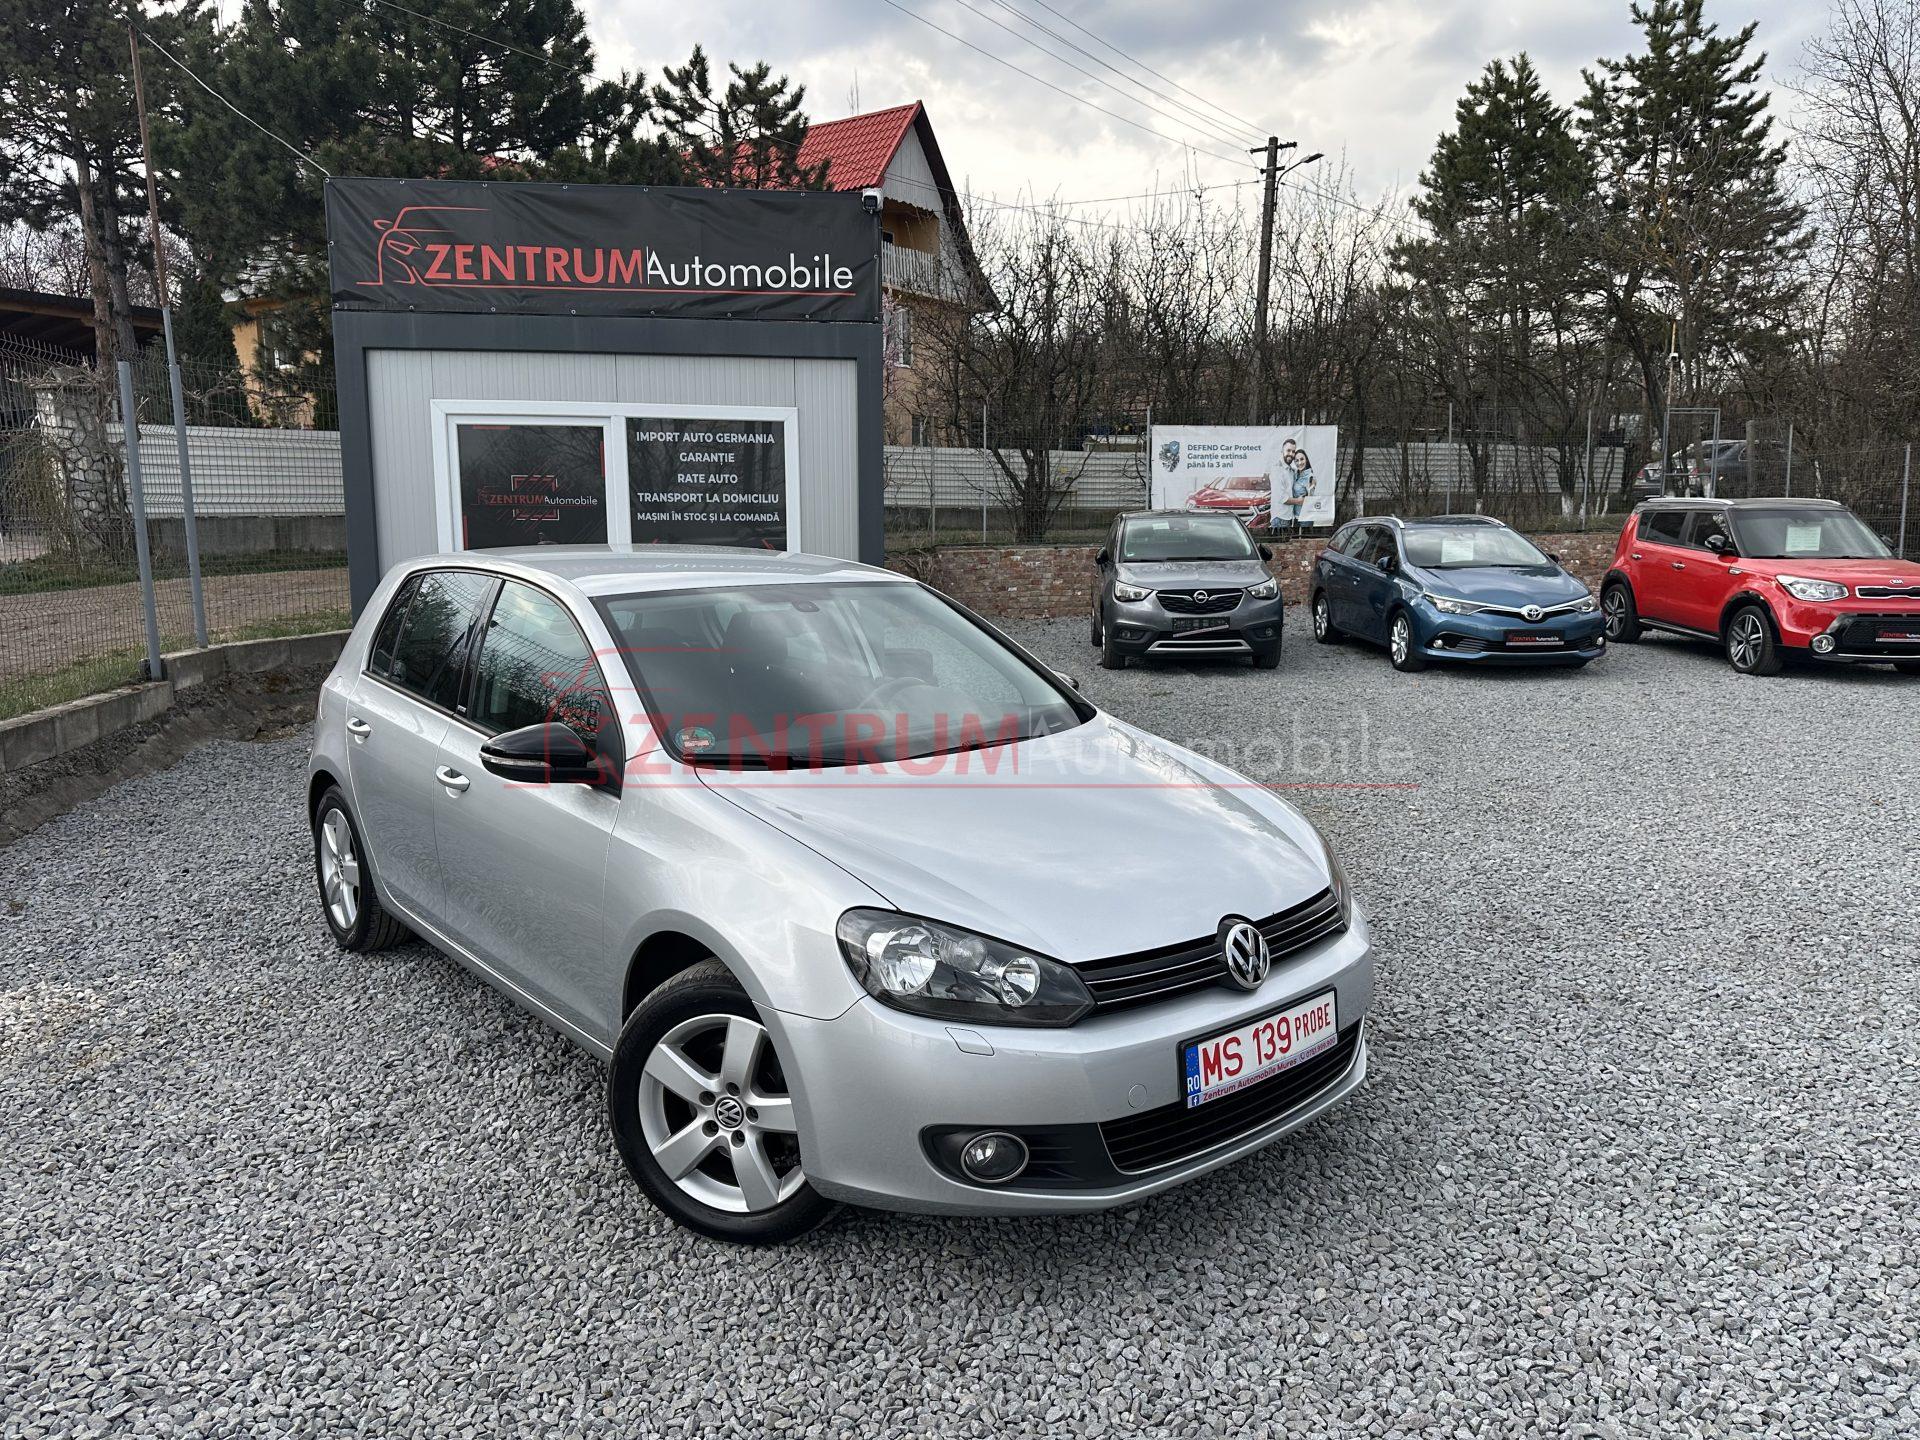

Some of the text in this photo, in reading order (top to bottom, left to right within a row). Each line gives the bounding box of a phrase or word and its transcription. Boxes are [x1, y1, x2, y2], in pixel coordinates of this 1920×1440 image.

[424, 244, 853, 288] ZENTRUM Automobile
[636, 431, 775, 444] IMPORT AUTO GERMANIA
[679, 452, 735, 465] GARANȚIE
[677, 473, 738, 484] RATE AUTO
[490, 494, 598, 505] ZENTRUM Automobile
[637, 492, 779, 504] TRANSPORT LA DOMICILIU
[637, 512, 670, 523] MAȘINI
[671, 510, 682, 521] ÎN
[683, 512, 707, 521] STOC
[719, 513, 731, 521] LA
[733, 512, 780, 522] COMANDĂ
[1202, 1002, 1331, 1087] MS 139 PROBE
[1187, 1074, 1200, 1093] RO
[1203, 1084, 1236, 1102] Zentrum
[1237, 1067, 1276, 1089] Automobile
